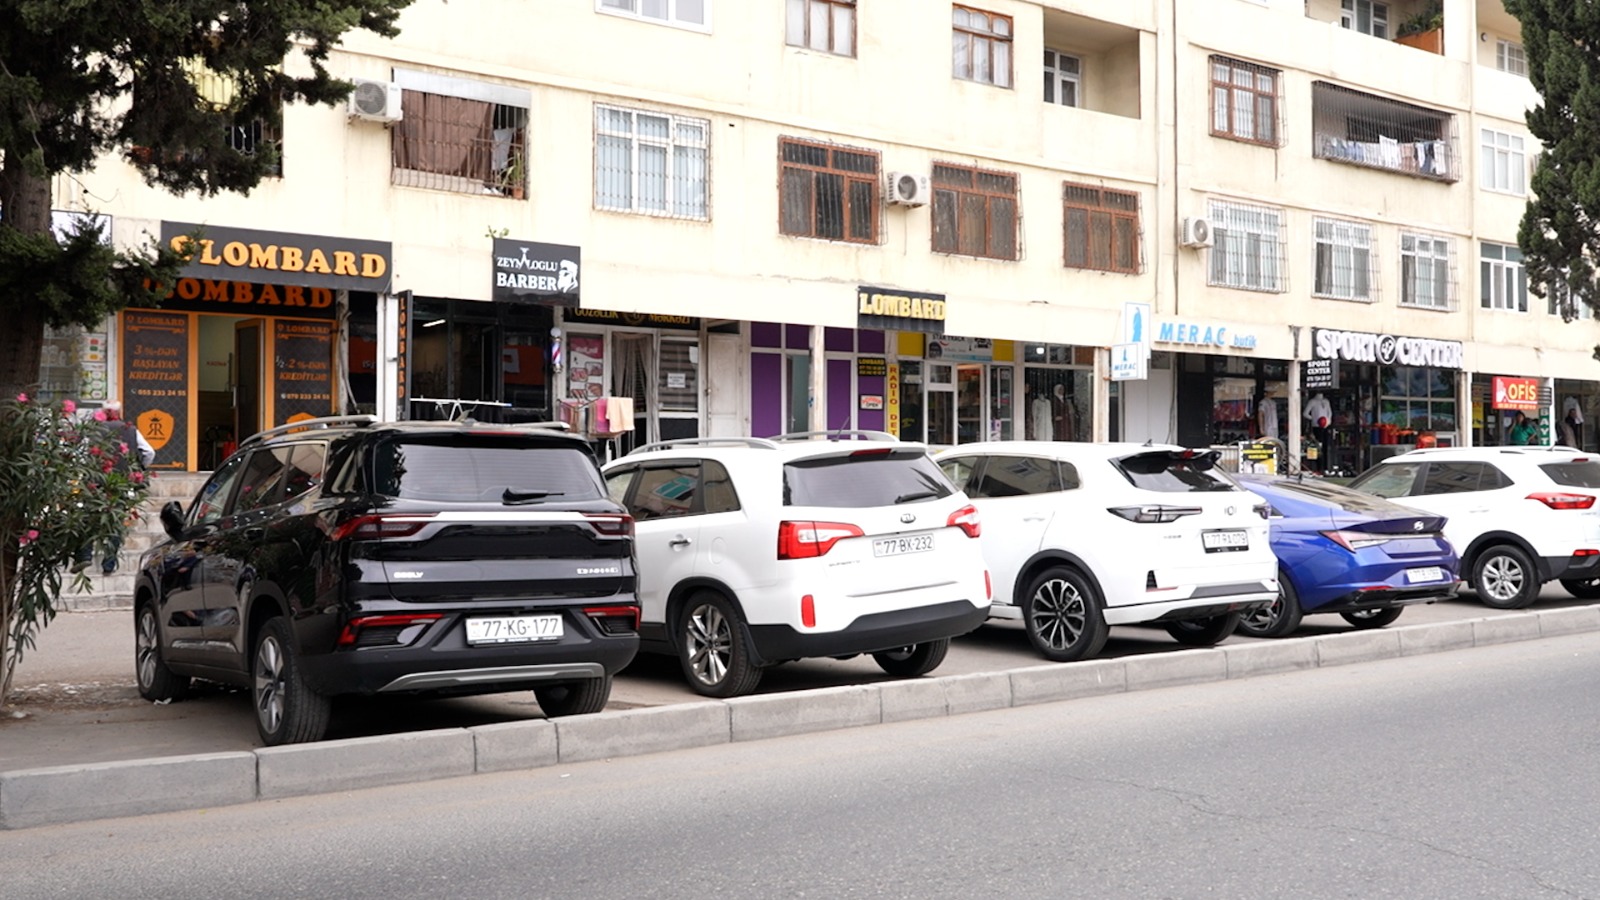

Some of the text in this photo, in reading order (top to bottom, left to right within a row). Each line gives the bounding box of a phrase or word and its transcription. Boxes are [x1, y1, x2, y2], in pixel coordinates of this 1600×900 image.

[199, 239, 386, 278] LOMBARD
[165, 277, 332, 308] OMBARD
[497, 271, 557, 291] BARBER
[859, 292, 945, 320] LOMBARD
[137, 316, 184, 326] LOMBARD
[287, 325, 330, 334] LOMBARD
[398, 297, 406, 398] LOMBARD
[1159, 322, 1257, 348] MERAC butik
[1316, 329, 1463, 369] SPORT CENTER
[1307, 360, 1330, 369] SPORT
[889, 366, 898, 405] RADIO
[1508, 380, 1537, 401] OFİS
[482, 618, 559, 637] 77-KG-177
